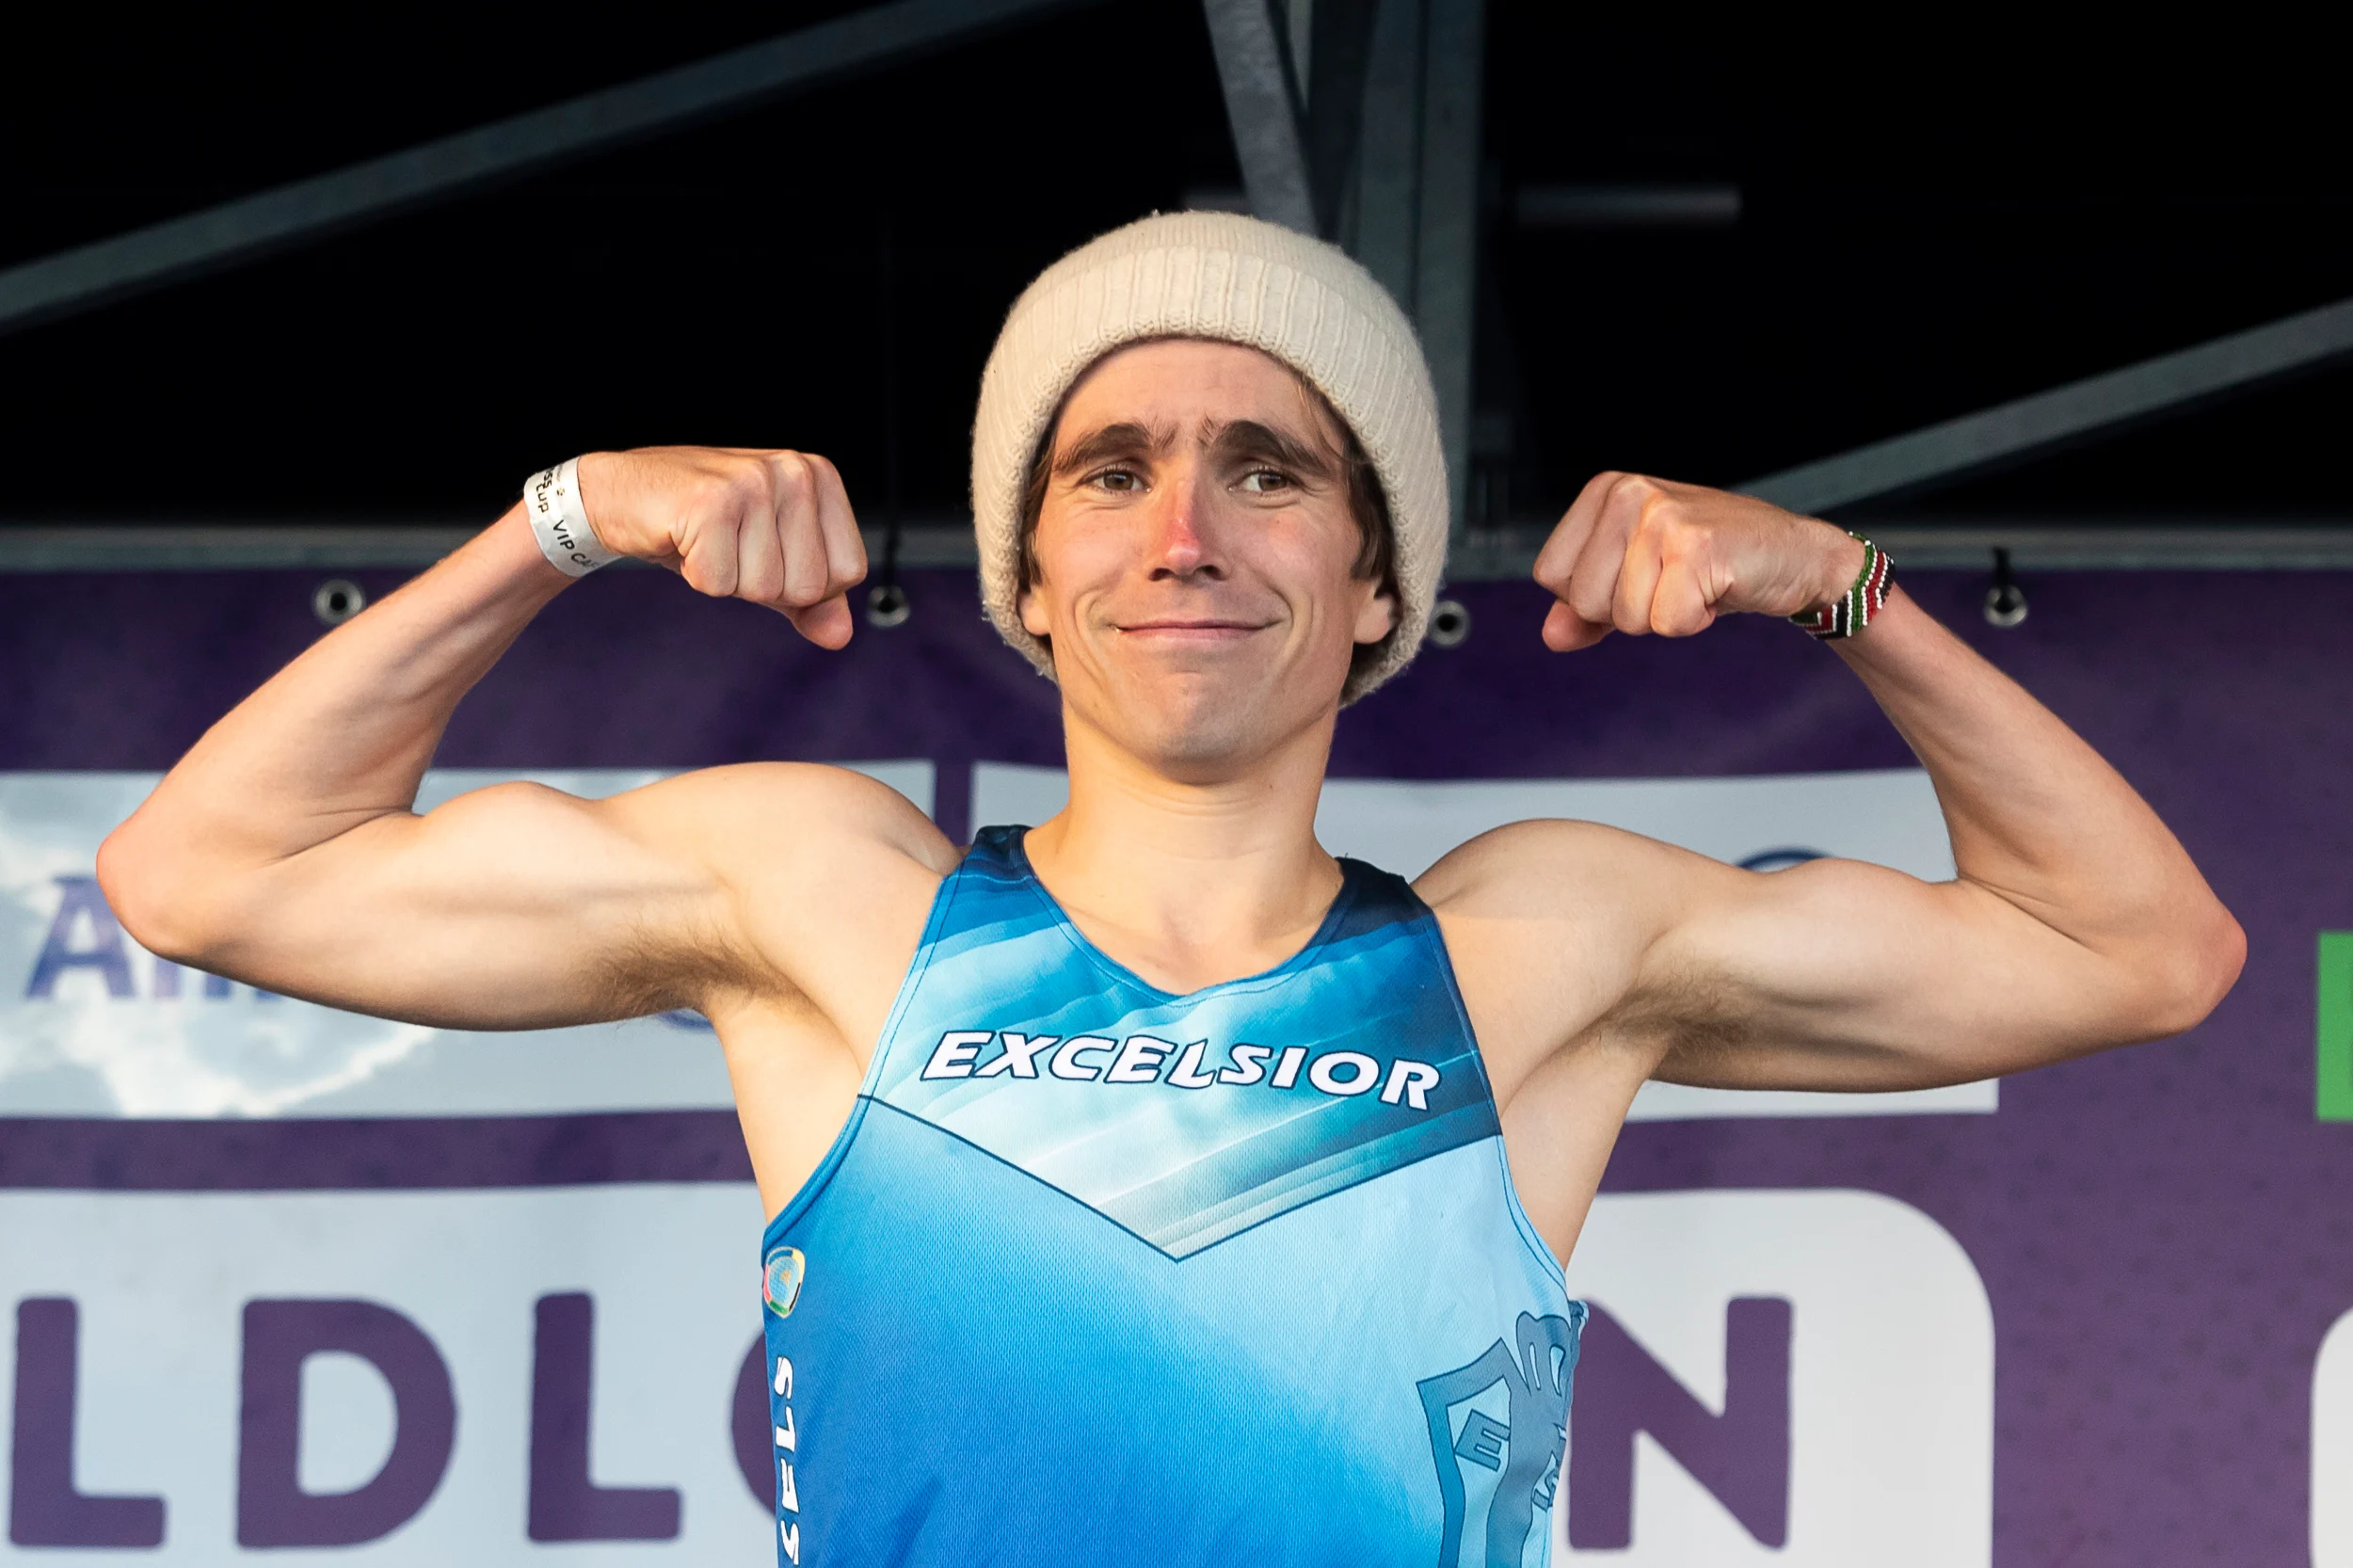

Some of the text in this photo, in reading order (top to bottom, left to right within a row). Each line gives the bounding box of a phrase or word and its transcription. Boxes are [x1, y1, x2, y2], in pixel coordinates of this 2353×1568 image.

[536, 483, 550, 513] CUP
[552, 519, 575, 551] VIP
[919, 1030, 1442, 1111] EXCELSIOR
